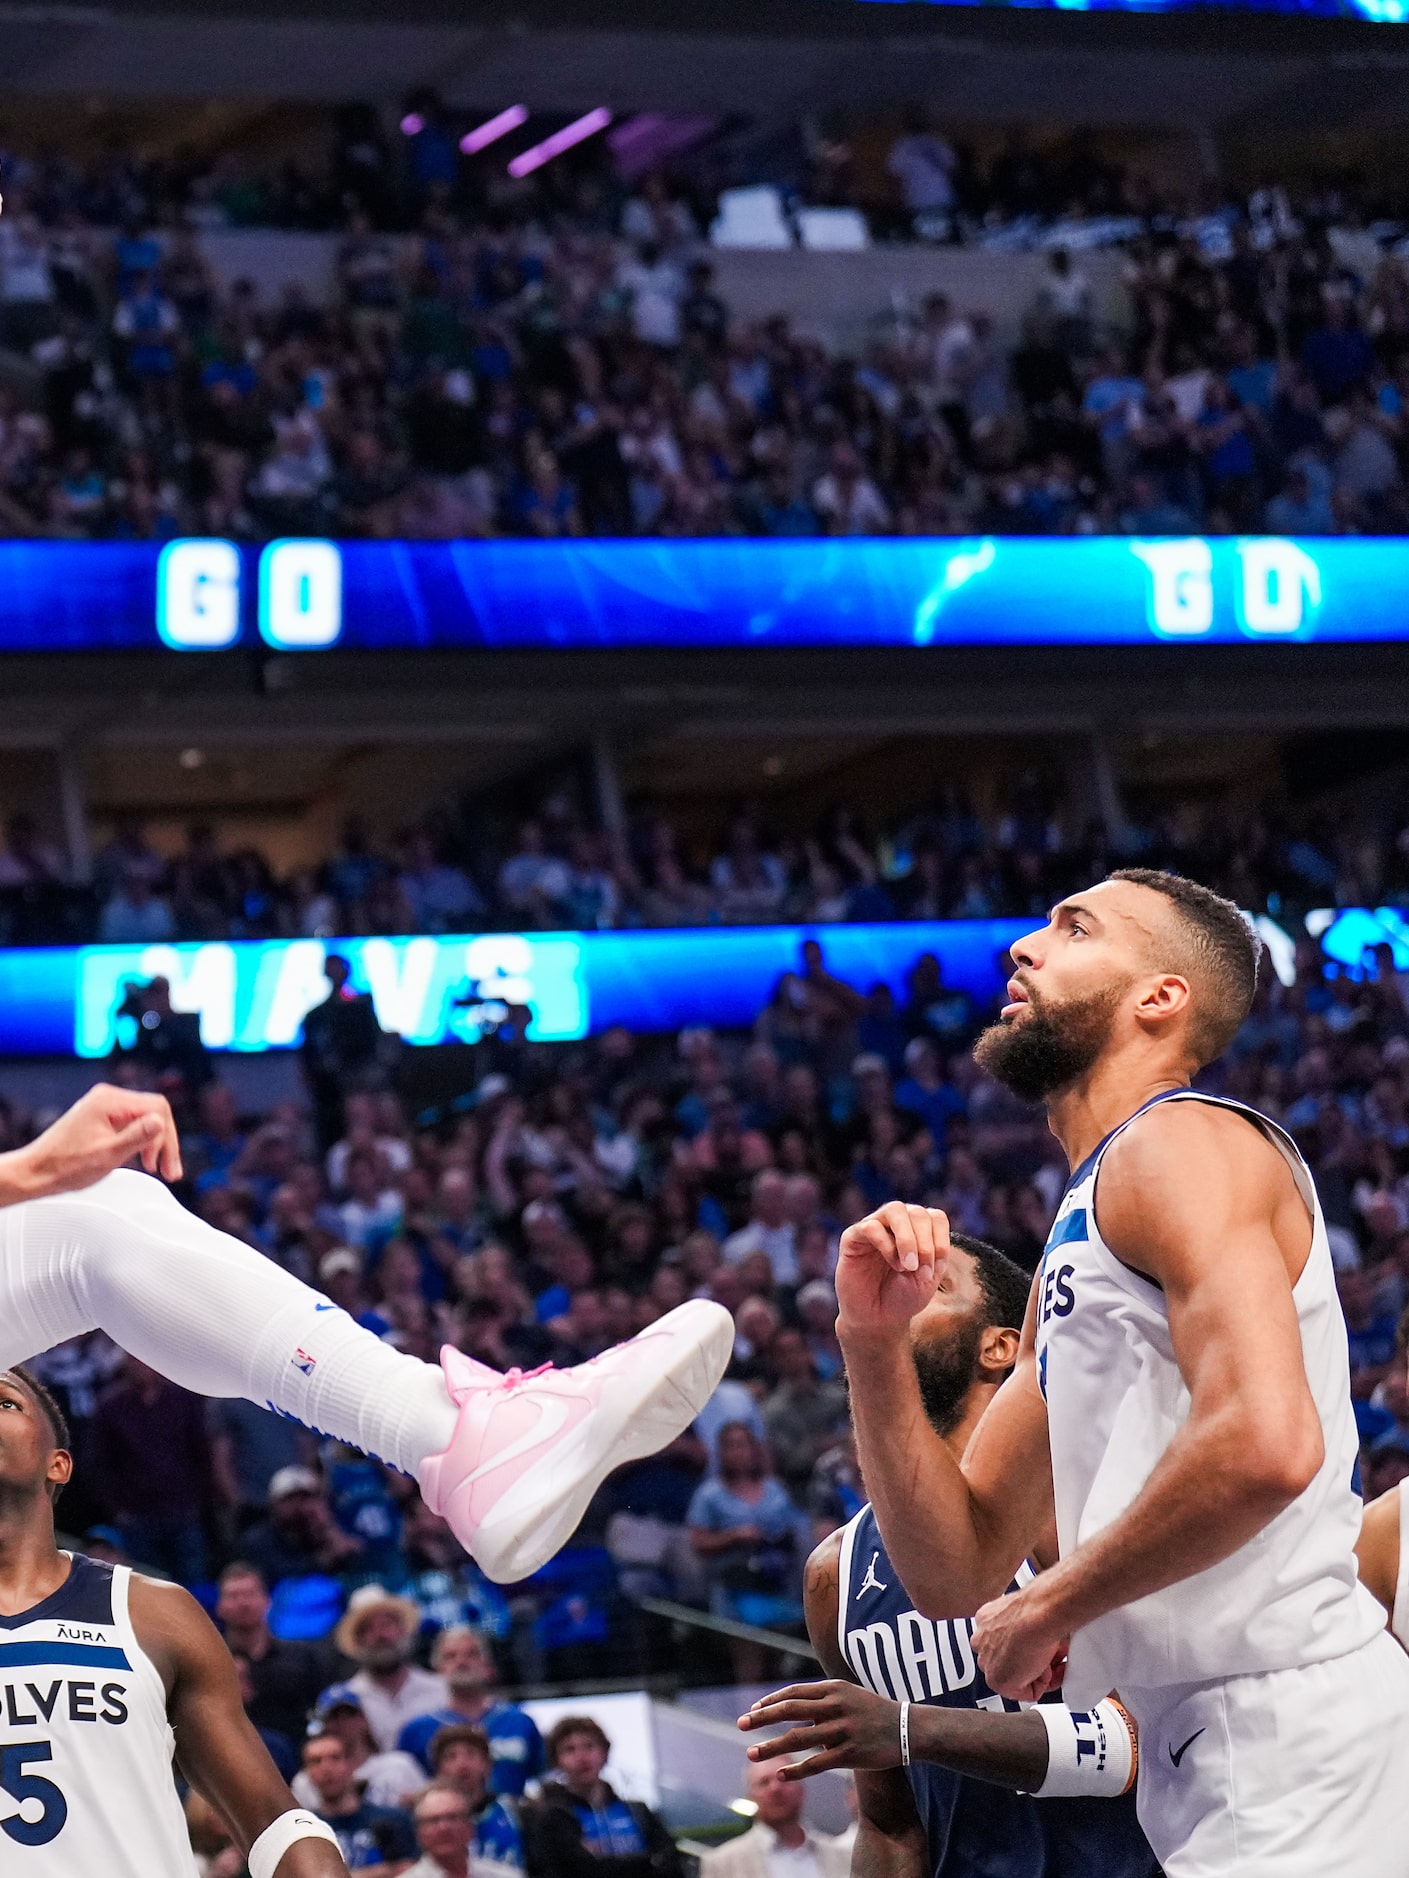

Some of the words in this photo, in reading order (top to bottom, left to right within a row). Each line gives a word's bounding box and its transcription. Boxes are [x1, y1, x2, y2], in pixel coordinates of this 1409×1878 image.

[159, 538, 341, 650] GO
[1039, 1264, 1076, 1326] ES
[847, 1609, 978, 1702] MAV
